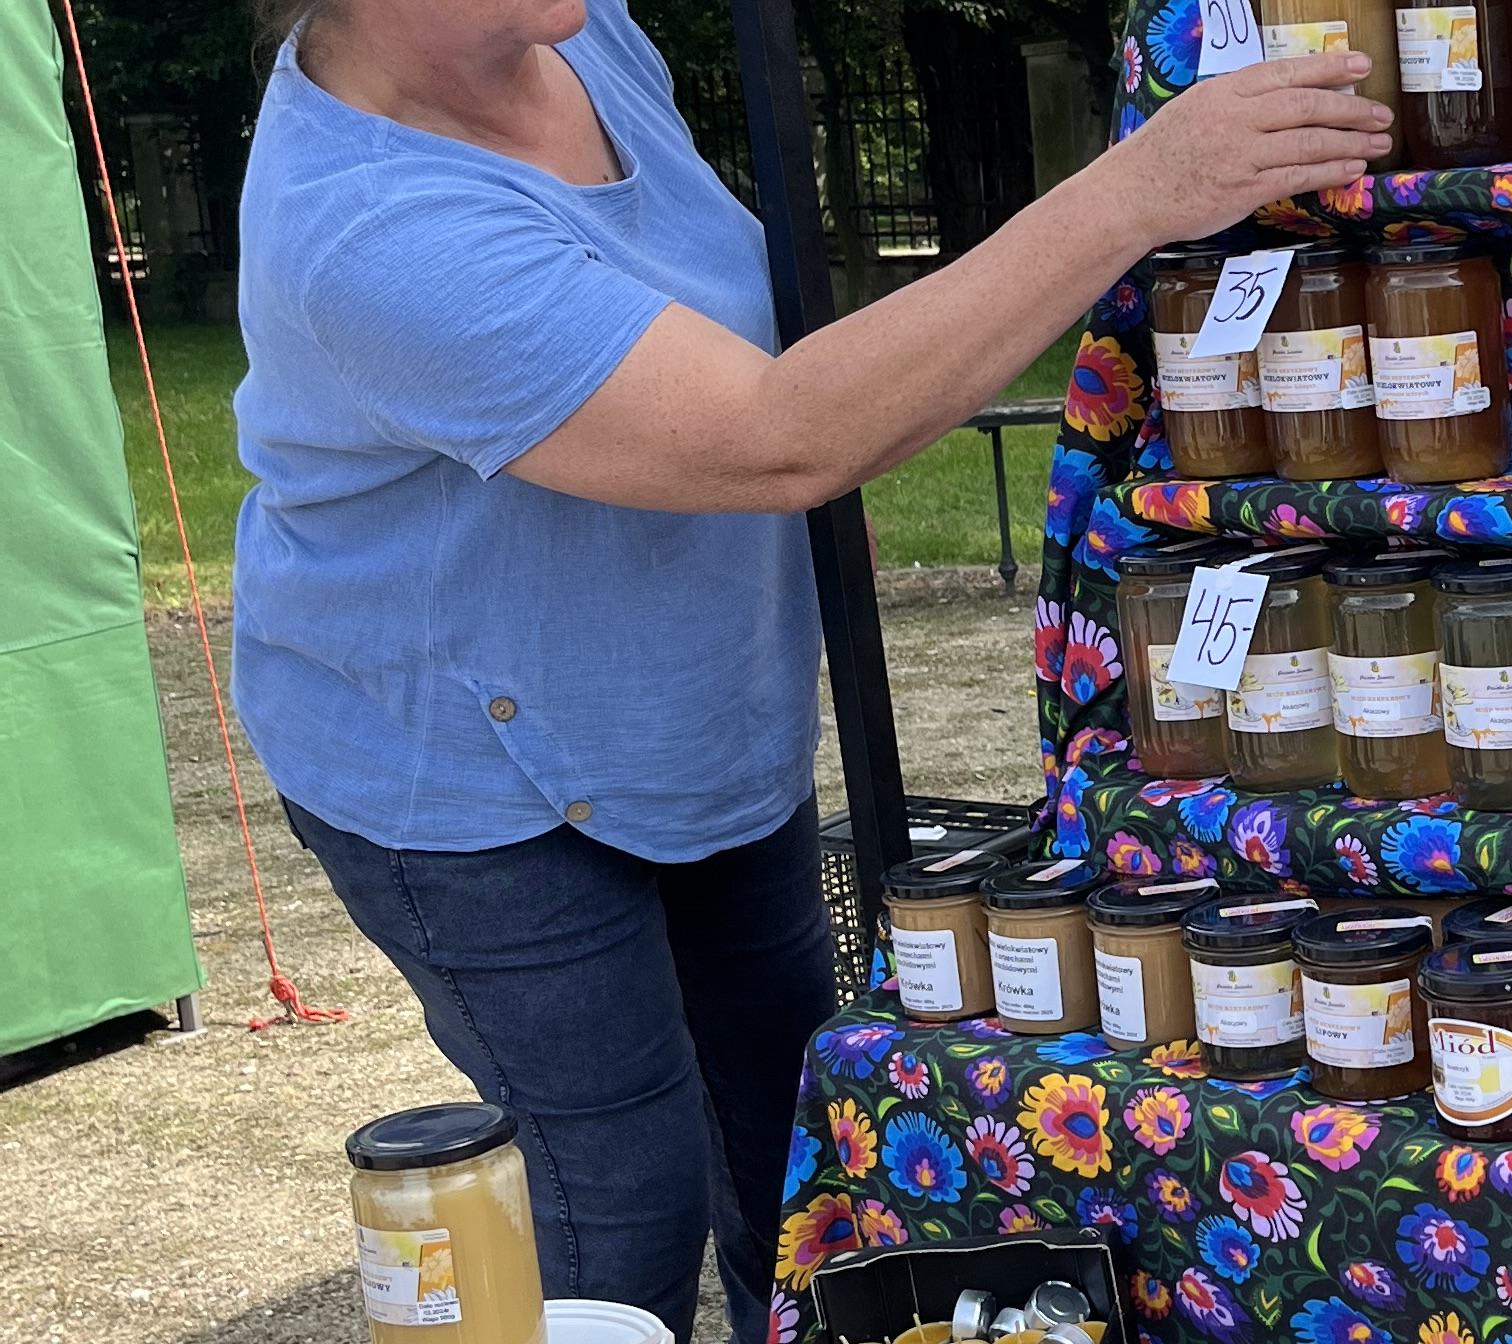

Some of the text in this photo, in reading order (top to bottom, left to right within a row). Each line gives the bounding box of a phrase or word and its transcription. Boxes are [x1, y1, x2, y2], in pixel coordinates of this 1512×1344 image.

[1213, 267, 1279, 323] 35
[900, 977, 934, 992] Krówka
[998, 979, 1034, 996] Krówka
[1431, 1029, 1500, 1057] Miód
